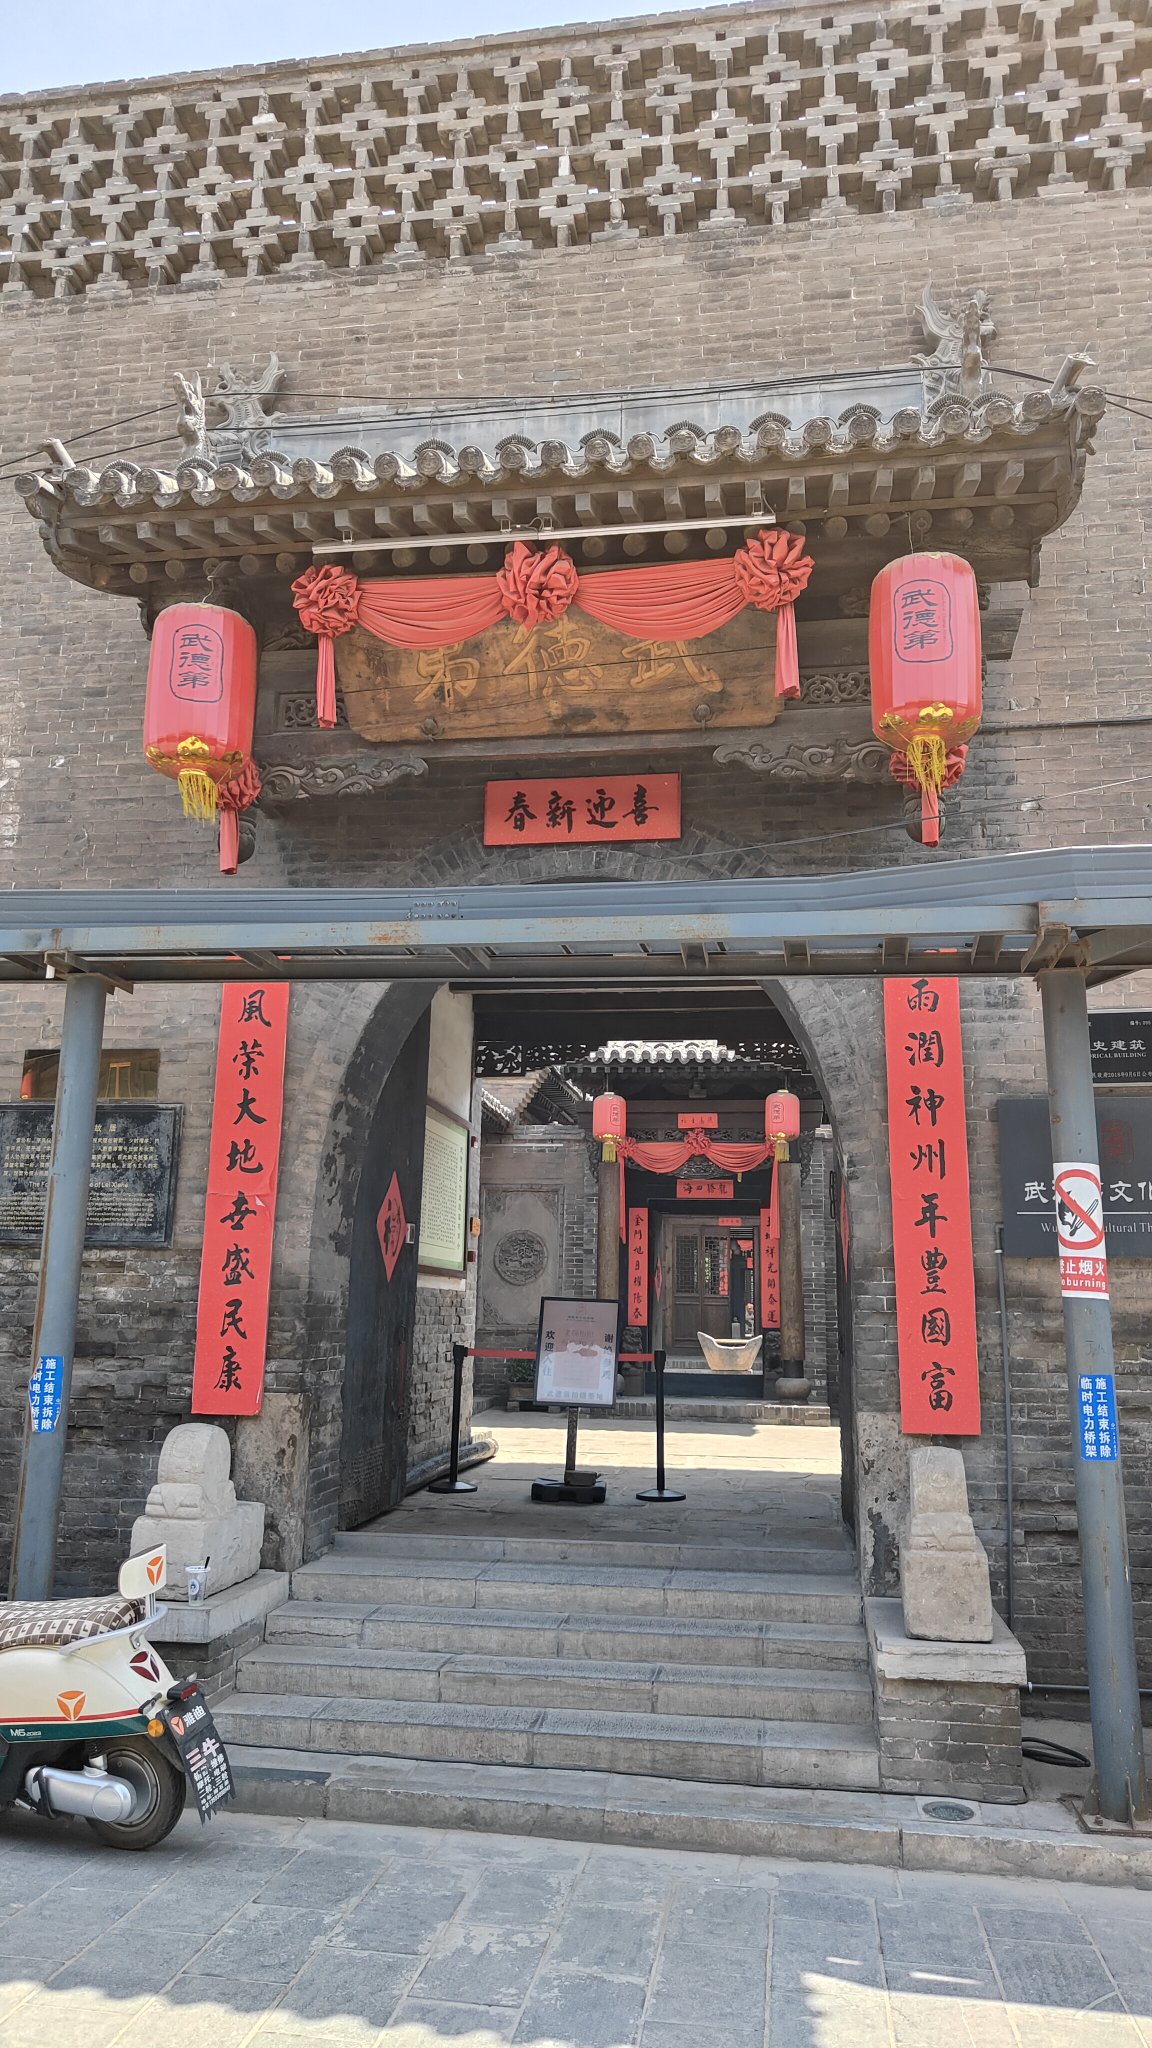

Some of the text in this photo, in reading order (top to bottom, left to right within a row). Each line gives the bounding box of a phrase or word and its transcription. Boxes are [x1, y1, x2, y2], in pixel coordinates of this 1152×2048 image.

[901, 589, 941, 650] 武德第
[177, 633, 213, 688] 武德第
[1091, 1039, 1147, 1051] 史建筑
[1024, 1180, 1152, 1204] 武文化
[1103, 1222, 1137, 1233] ultural
[1139, 1222, 1152, 1233] Th
[41, 1358, 57, 1430] 施工结束拆除
[1081, 1377, 1097, 1457] 临时电力桥架
[1095, 1377, 1112, 1457] 施工结束拆除
[183, 1705, 207, 1728] 雅迪
[186, 1738, 220, 1773] 三牛
